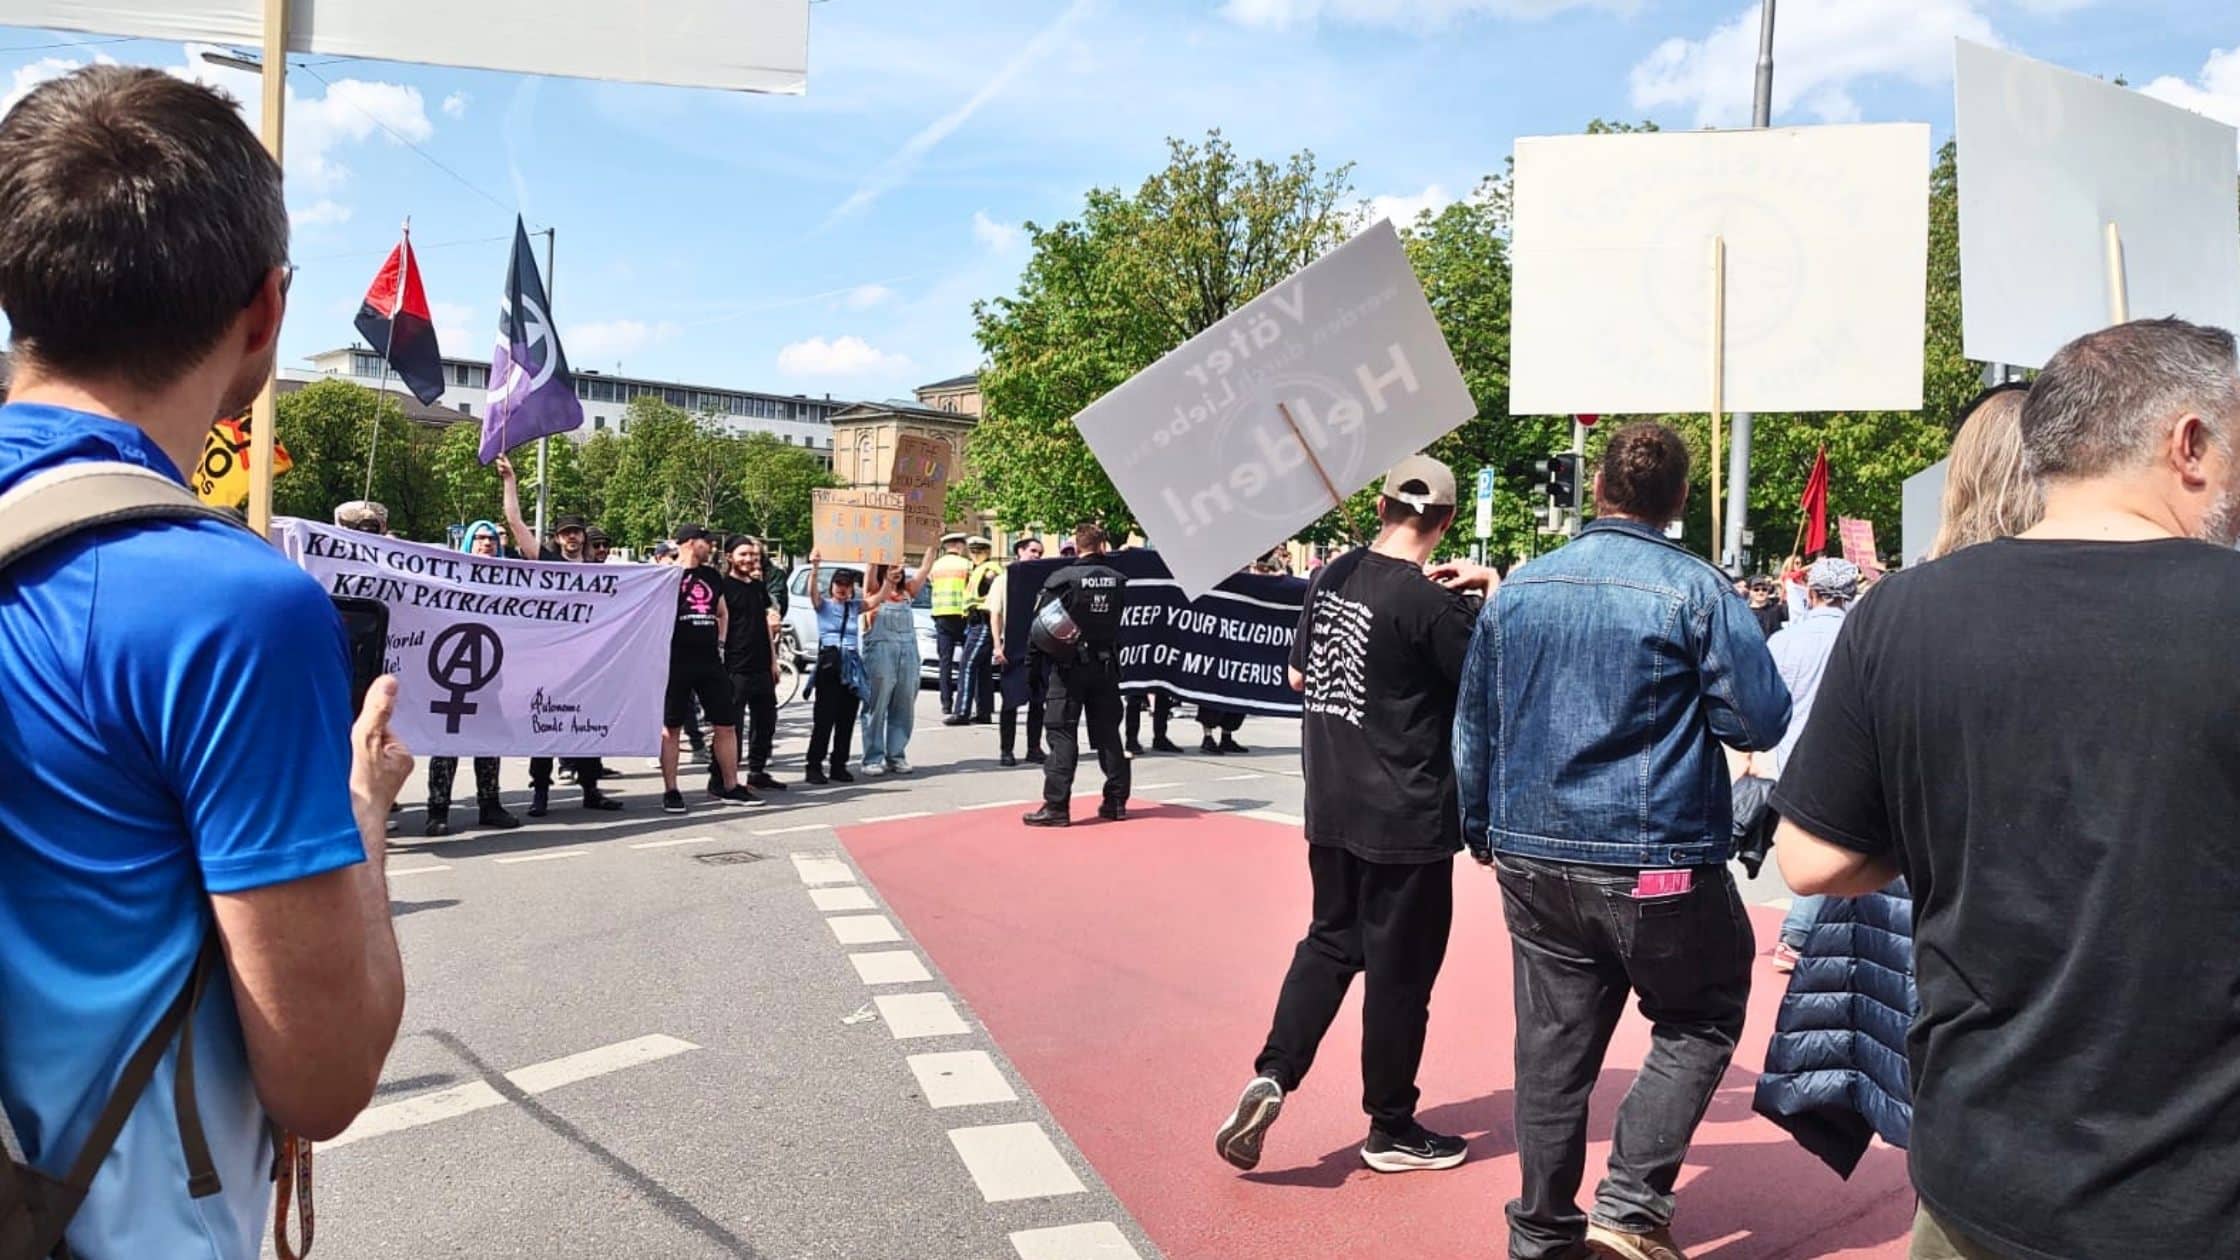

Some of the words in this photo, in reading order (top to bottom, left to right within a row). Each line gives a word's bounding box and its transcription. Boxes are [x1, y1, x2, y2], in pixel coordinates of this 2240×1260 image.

[303, 531, 380, 564] KEIN
[387, 551, 462, 583] GOTT,
[470, 564, 535, 587] KEIN
[540, 571, 618, 597] STAAT,
[332, 573, 410, 602] KEIN
[412, 588, 594, 623] PATRIARCHAT!
[1120, 605, 1161, 628] KEEP
[1166, 607, 1216, 636] YOUR
[1219, 617, 1297, 649] RELIGION
[1120, 644, 1151, 667] OUT
[1153, 644, 1180, 667] OF
[1182, 652, 1214, 678] MY
[1217, 658, 1283, 687] UTERUS
